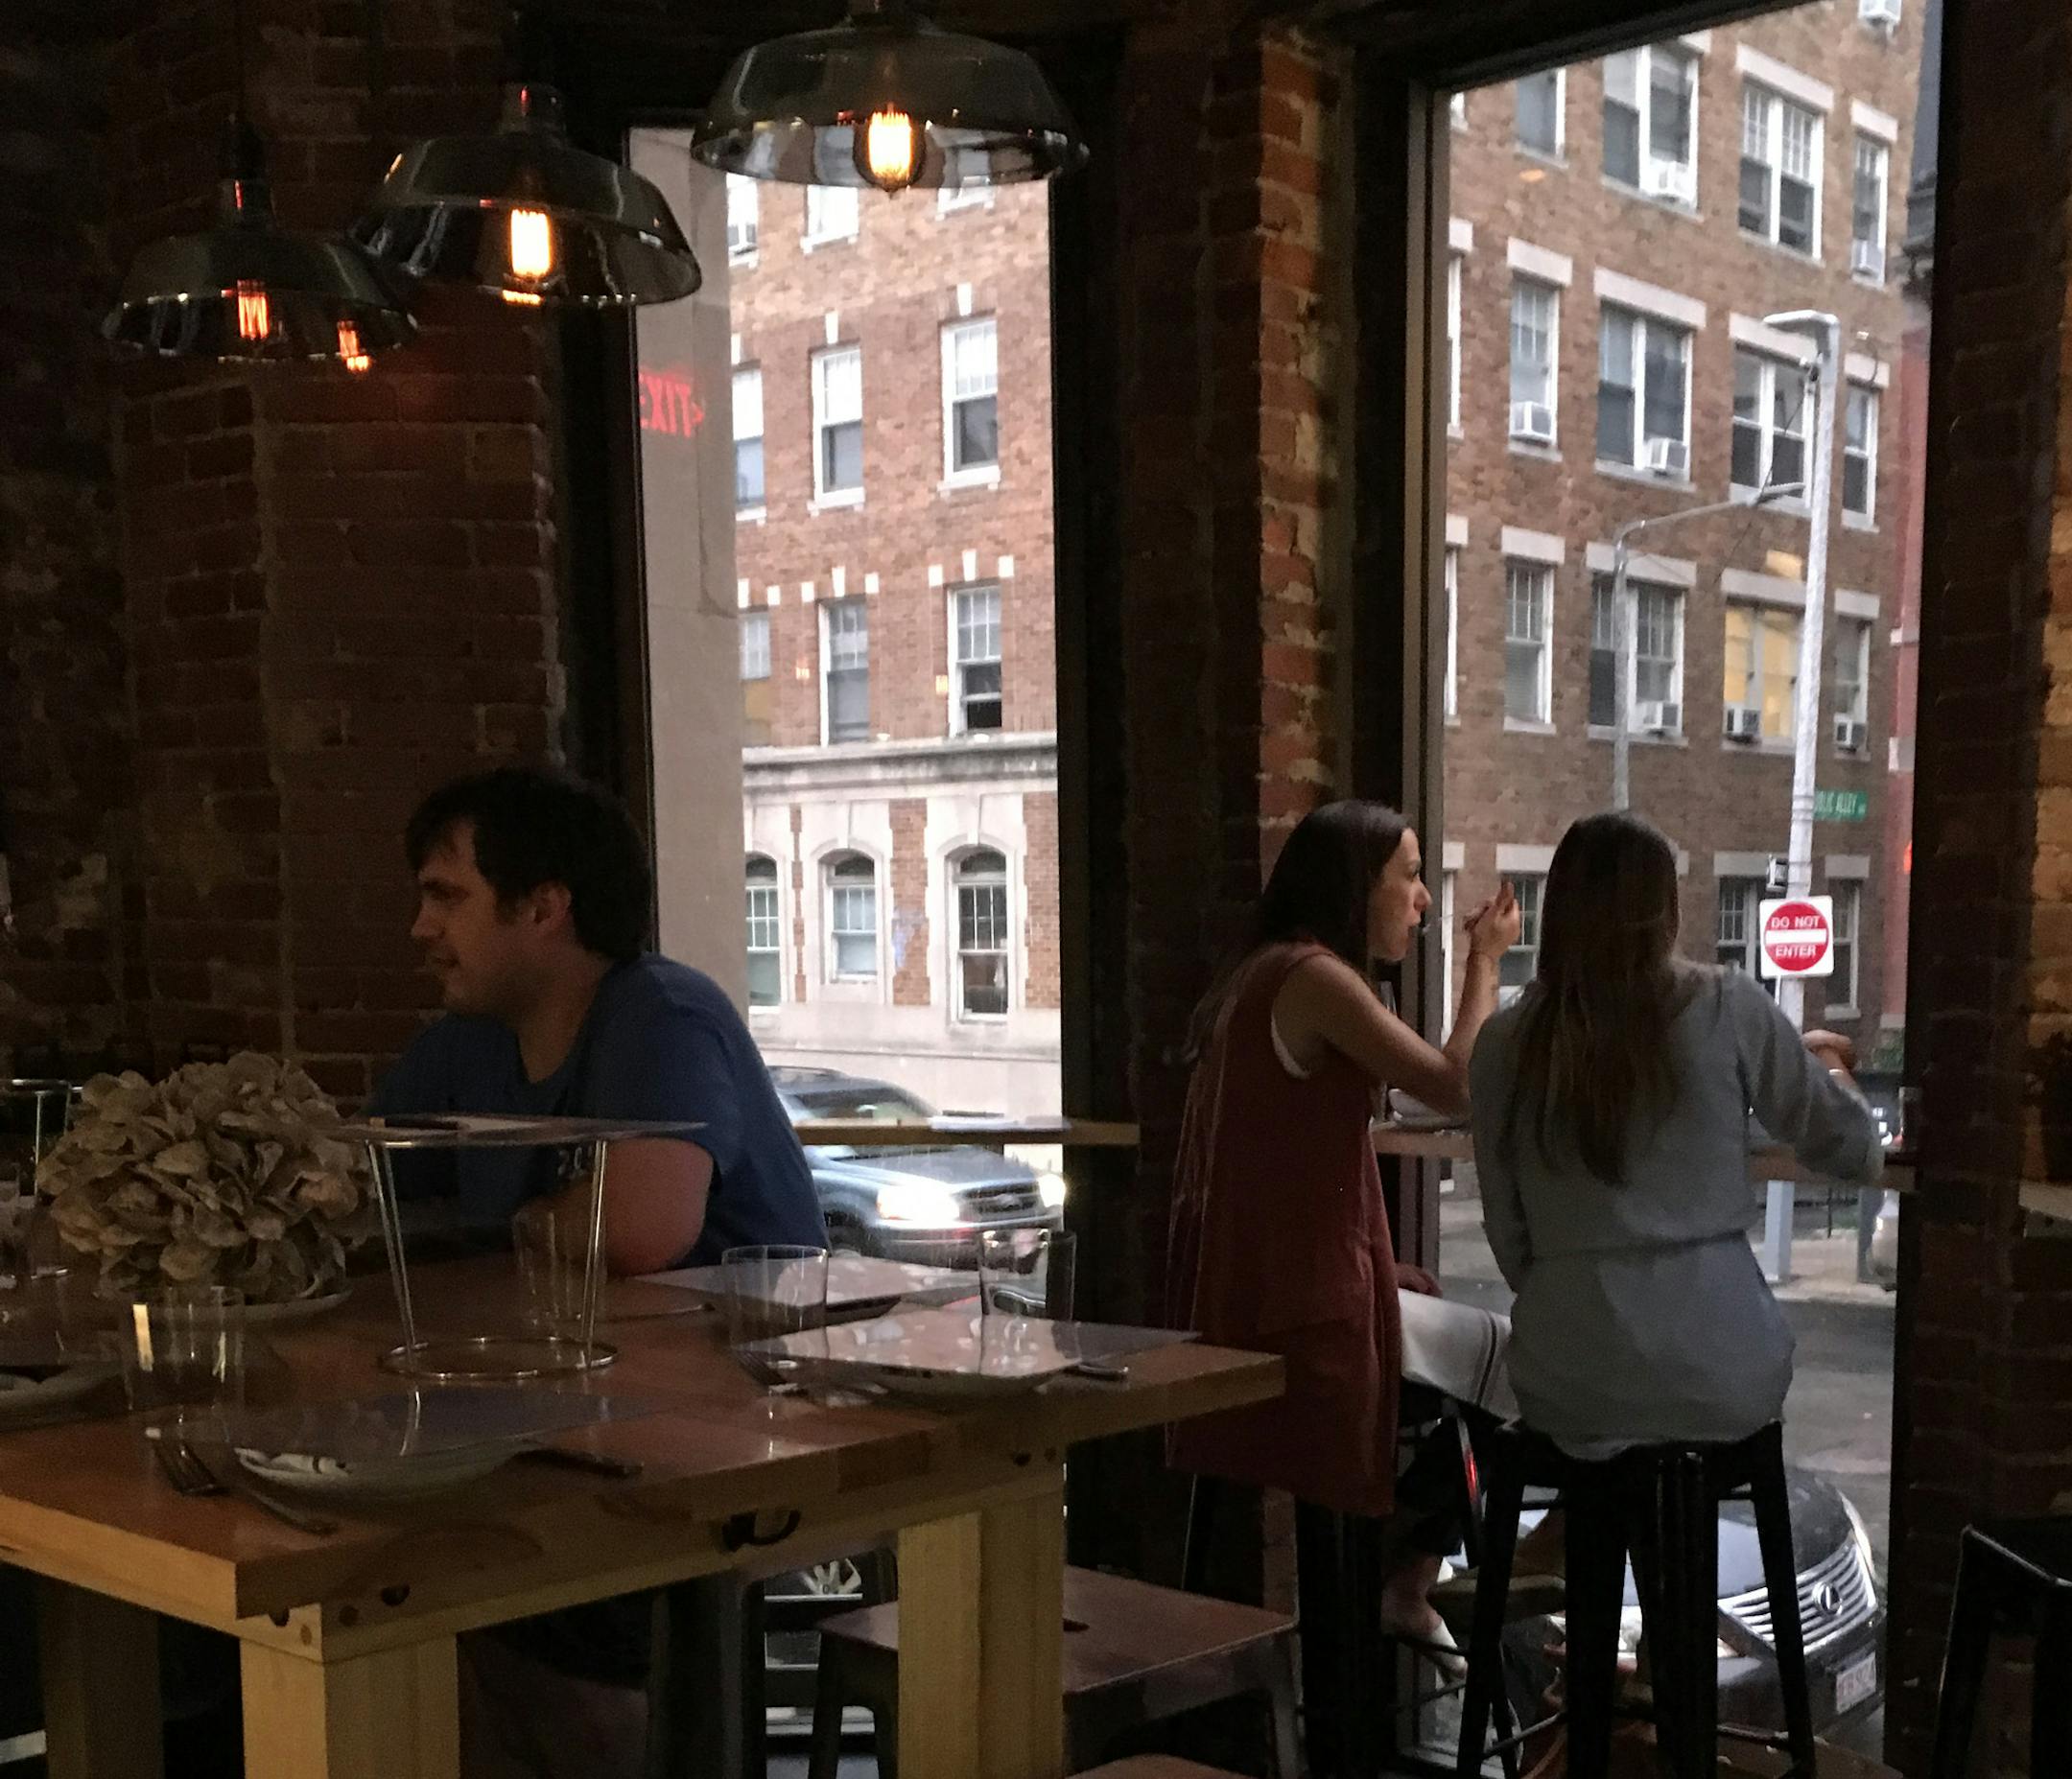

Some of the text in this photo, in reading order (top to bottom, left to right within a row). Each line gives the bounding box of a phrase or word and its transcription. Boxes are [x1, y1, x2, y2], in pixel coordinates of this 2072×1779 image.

[1771, 915, 1820, 928] DO NOT
[1775, 944, 1816, 957] ENTER
